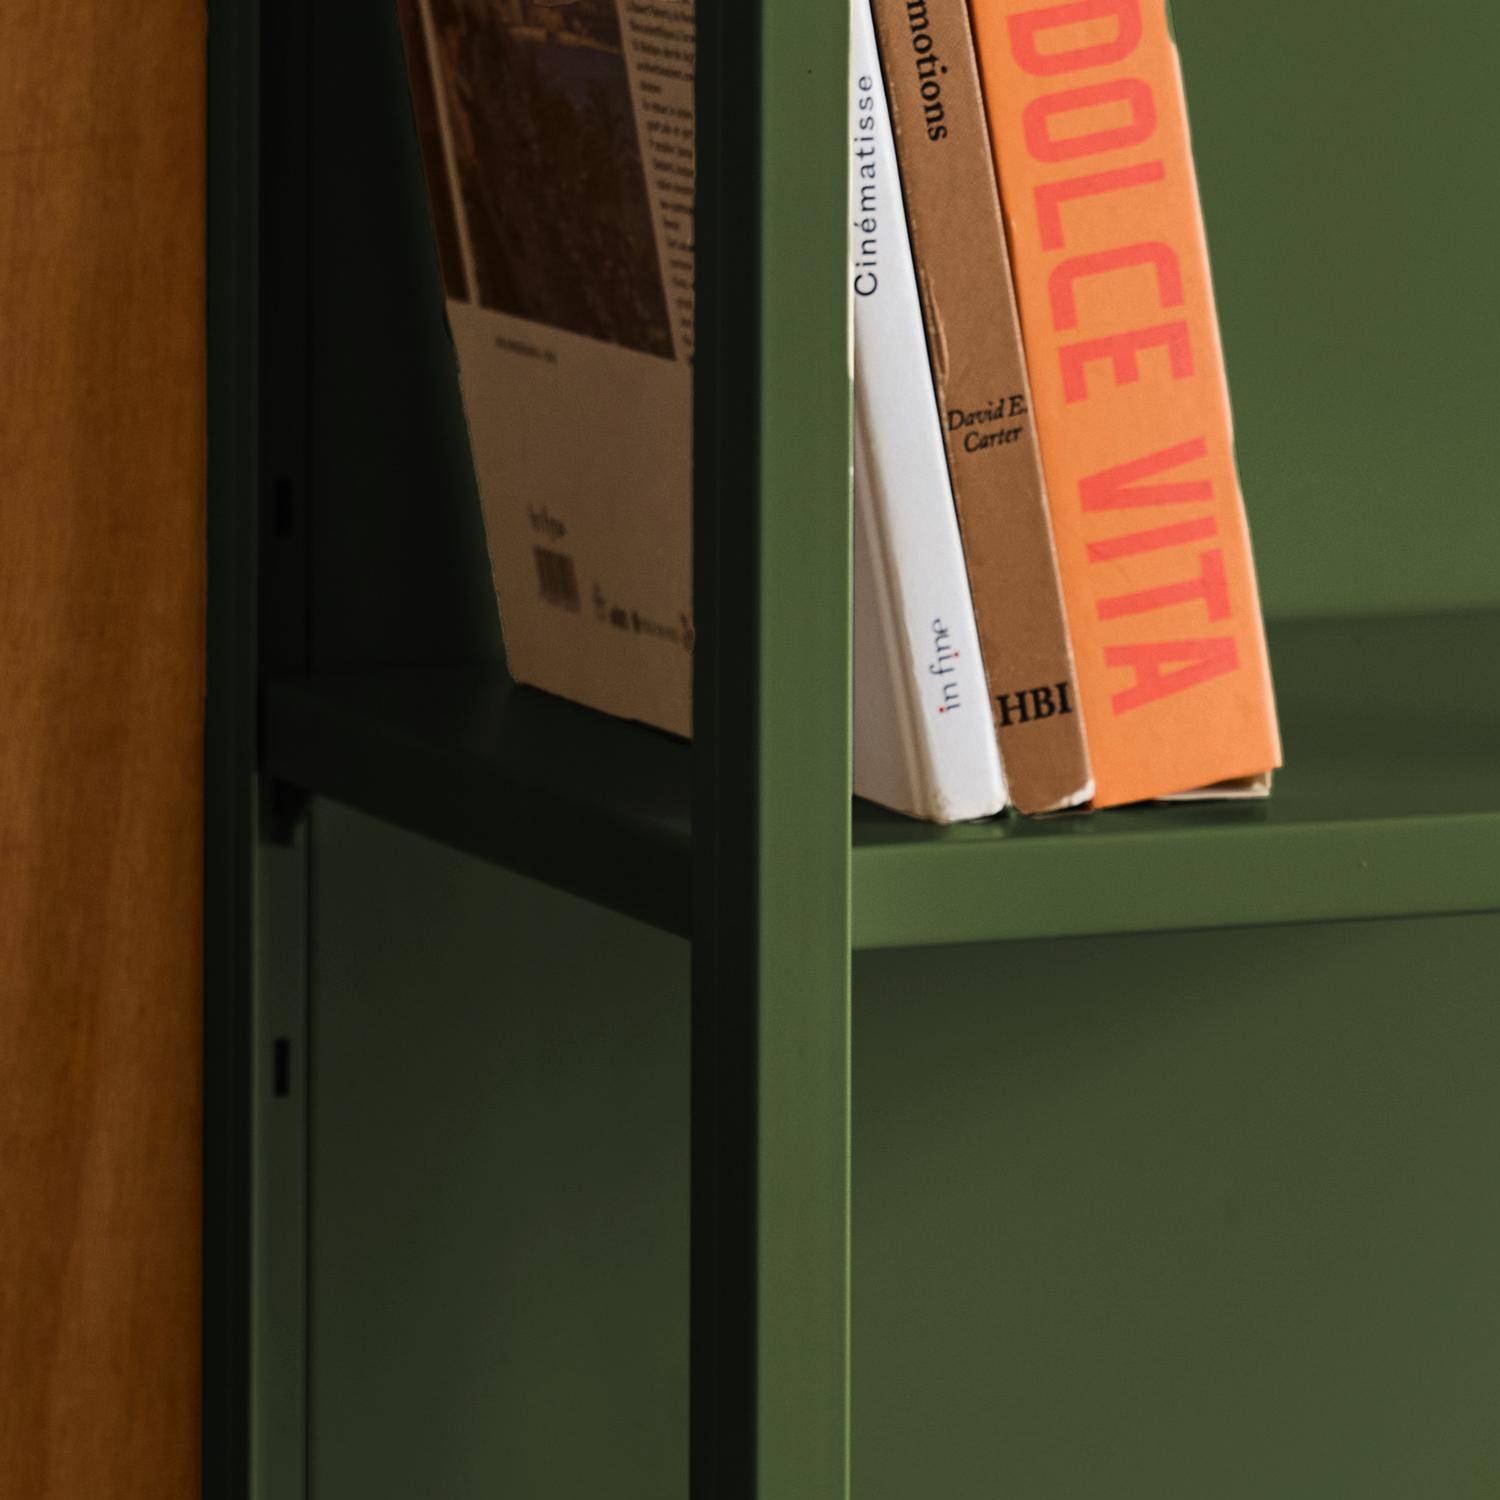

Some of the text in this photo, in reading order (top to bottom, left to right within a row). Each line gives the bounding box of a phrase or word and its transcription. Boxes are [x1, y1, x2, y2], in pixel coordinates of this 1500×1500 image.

[853, 75, 878, 297] Cinématisse
[1007, 0, 1239, 717] DOLCE VITA
[947, 398, 1005, 431] David
[964, 427, 1023, 453] Carter
[938, 682, 961, 713] in
[996, 681, 1073, 728] HBI
